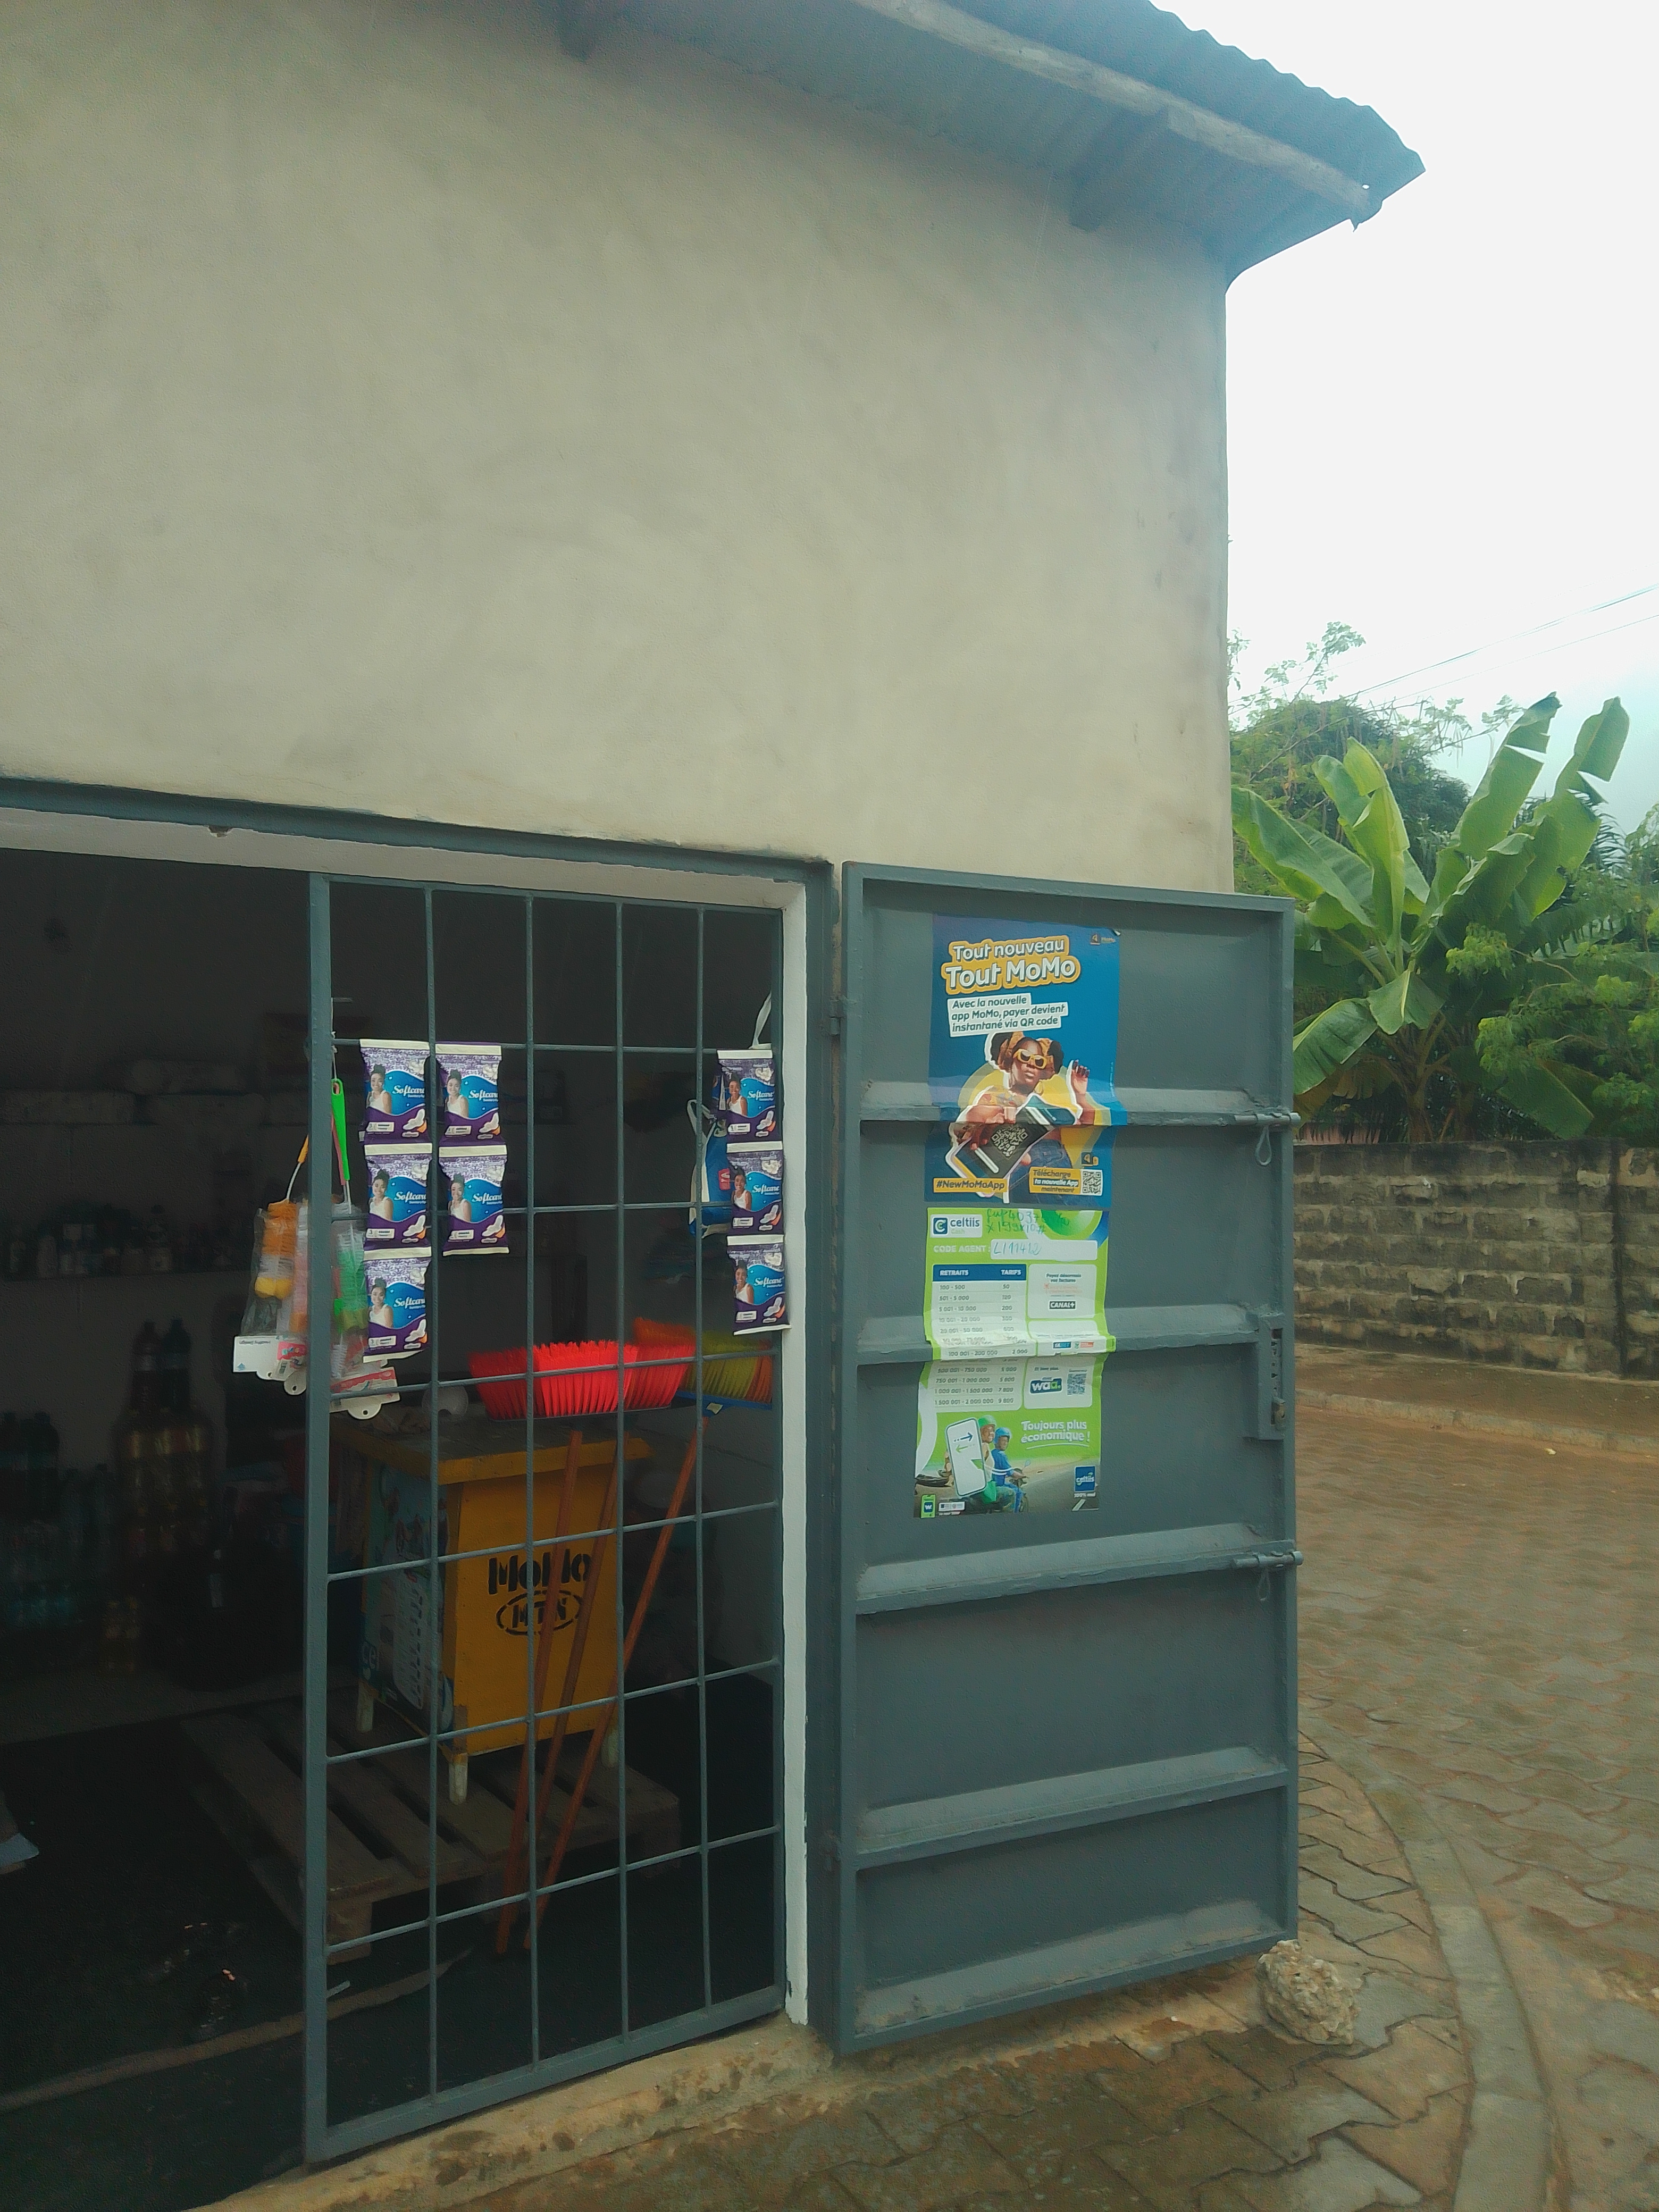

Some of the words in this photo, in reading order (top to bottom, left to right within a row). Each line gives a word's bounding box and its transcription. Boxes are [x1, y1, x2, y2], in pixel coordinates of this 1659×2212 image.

[953, 943, 991, 960] Tout
[994, 940, 1064, 957] nouveau
[945, 963, 1001, 988] Tout
[1006, 956, 1075, 982] MoMo
[952, 1000, 975, 1009] Avec
[977, 998, 985, 1007] la
[987, 995, 1027, 1007] nouvelle
[952, 1012, 969, 1022] app
[972, 1009, 1002, 1019] MoMo,
[1003, 1009, 1029, 1019] payer
[1032, 1004, 1066, 1015] devient
[952, 1019, 1002, 1032] instantané
[1004, 1019, 1018, 1028] via
[1020, 1018, 1034, 1027] QR
[1036, 1016, 1058, 1025] code
[752, 1184, 780, 1194] Softcare
[936, 1179, 1005, 1191] #NewMoMoApp
[950, 1217, 980, 1227] celtiis
[753, 1277, 782, 1287] Softcare
[1021, 1420, 1064, 1431] Toujours
[1067, 1419, 1087, 1431] plus
[1021, 1429, 1084, 1443] économique
[1086, 1431, 1091, 1442] !
